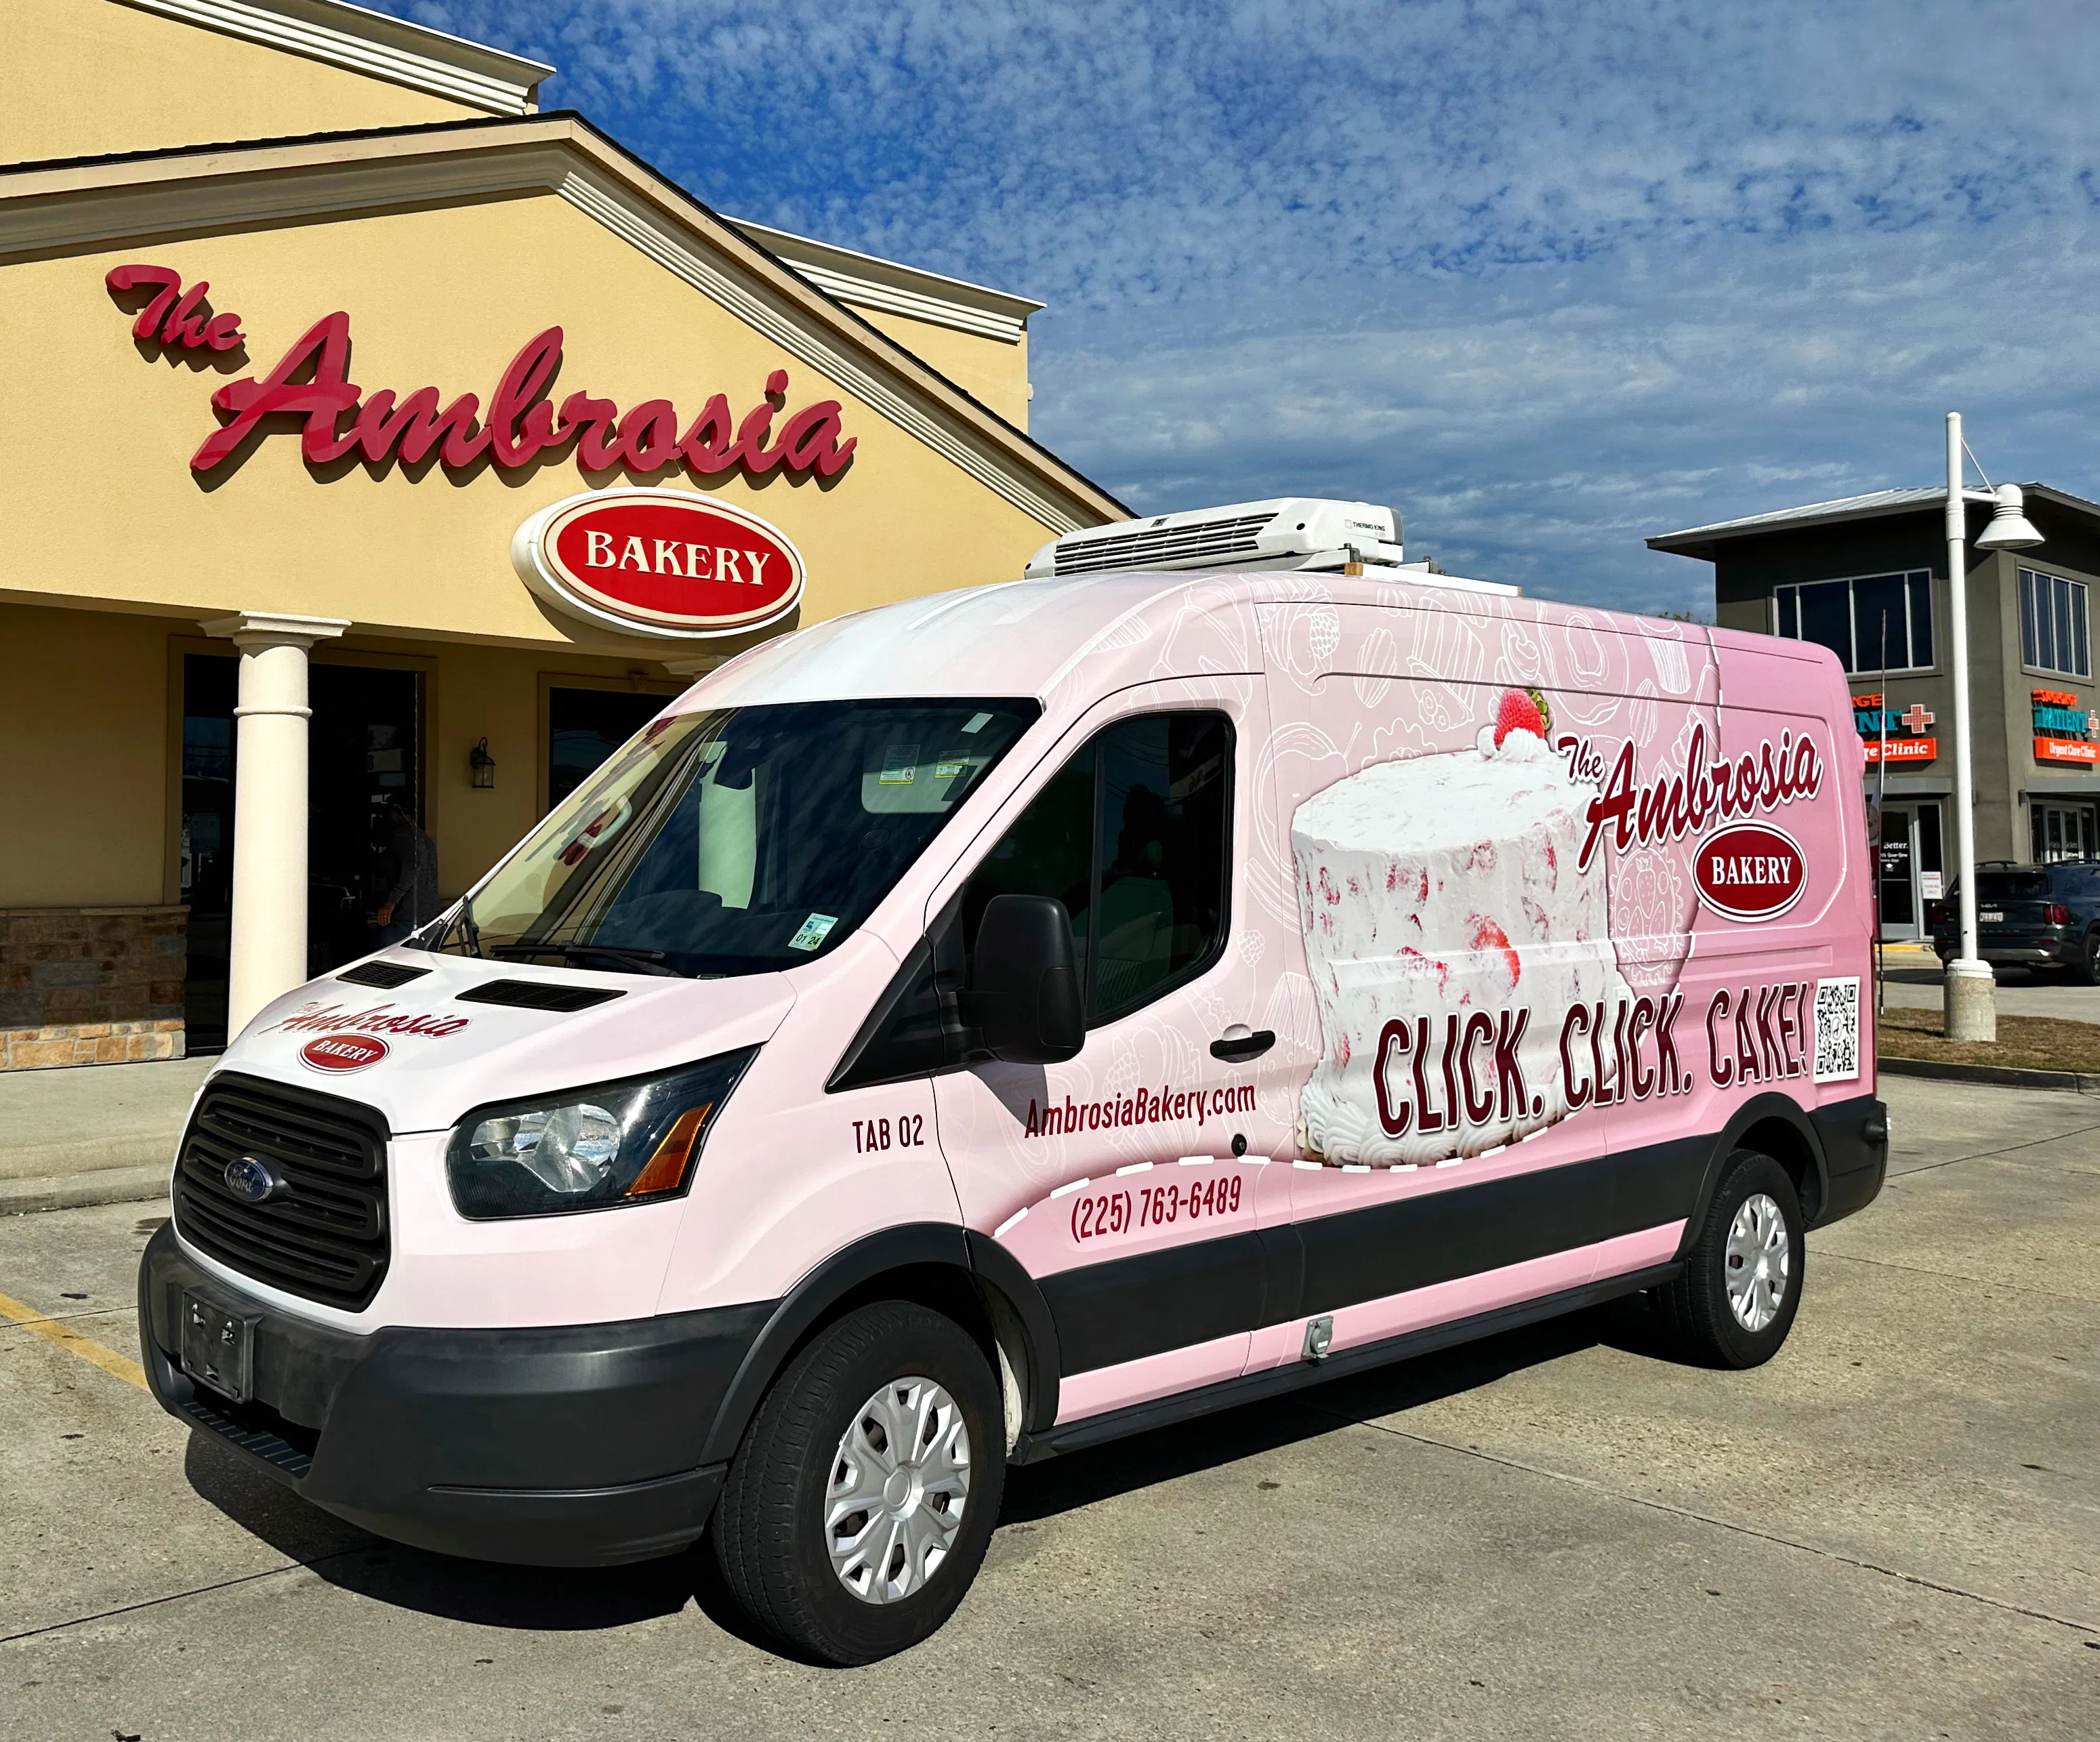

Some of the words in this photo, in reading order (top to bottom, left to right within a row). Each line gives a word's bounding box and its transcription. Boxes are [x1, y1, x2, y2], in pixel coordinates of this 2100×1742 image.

[106, 264, 245, 351] The
[190, 311, 857, 476] Ambrosia
[584, 530, 771, 587] BAKERY
[2040, 707, 2086, 732] PATIENT
[1556, 733, 1605, 783] The
[1883, 742, 1928, 756] Clinic
[1577, 721, 1823, 873] Ambrosia
[1711, 856, 1792, 885] BAKERY
[796, 934, 807, 943] 01
[808, 936, 821, 945] 24
[258, 1003, 469, 1037] Ambrosia
[312, 1040, 379, 1062] BAKERY
[1373, 1006, 1544, 1138] CLICK.
[1560, 993, 1693, 1111] CLICK.
[1706, 981, 1808, 1087] CAKE!
[1025, 1085, 1256, 1138] AmbrosiaBakery.com
[852, 1118, 890, 1153] TAB
[899, 1115, 924, 1147] 02
[230, 1165, 255, 1193] Ford
[1071, 1190, 1132, 1243] (225)
[1140, 1175, 1242, 1227] 763-6489
